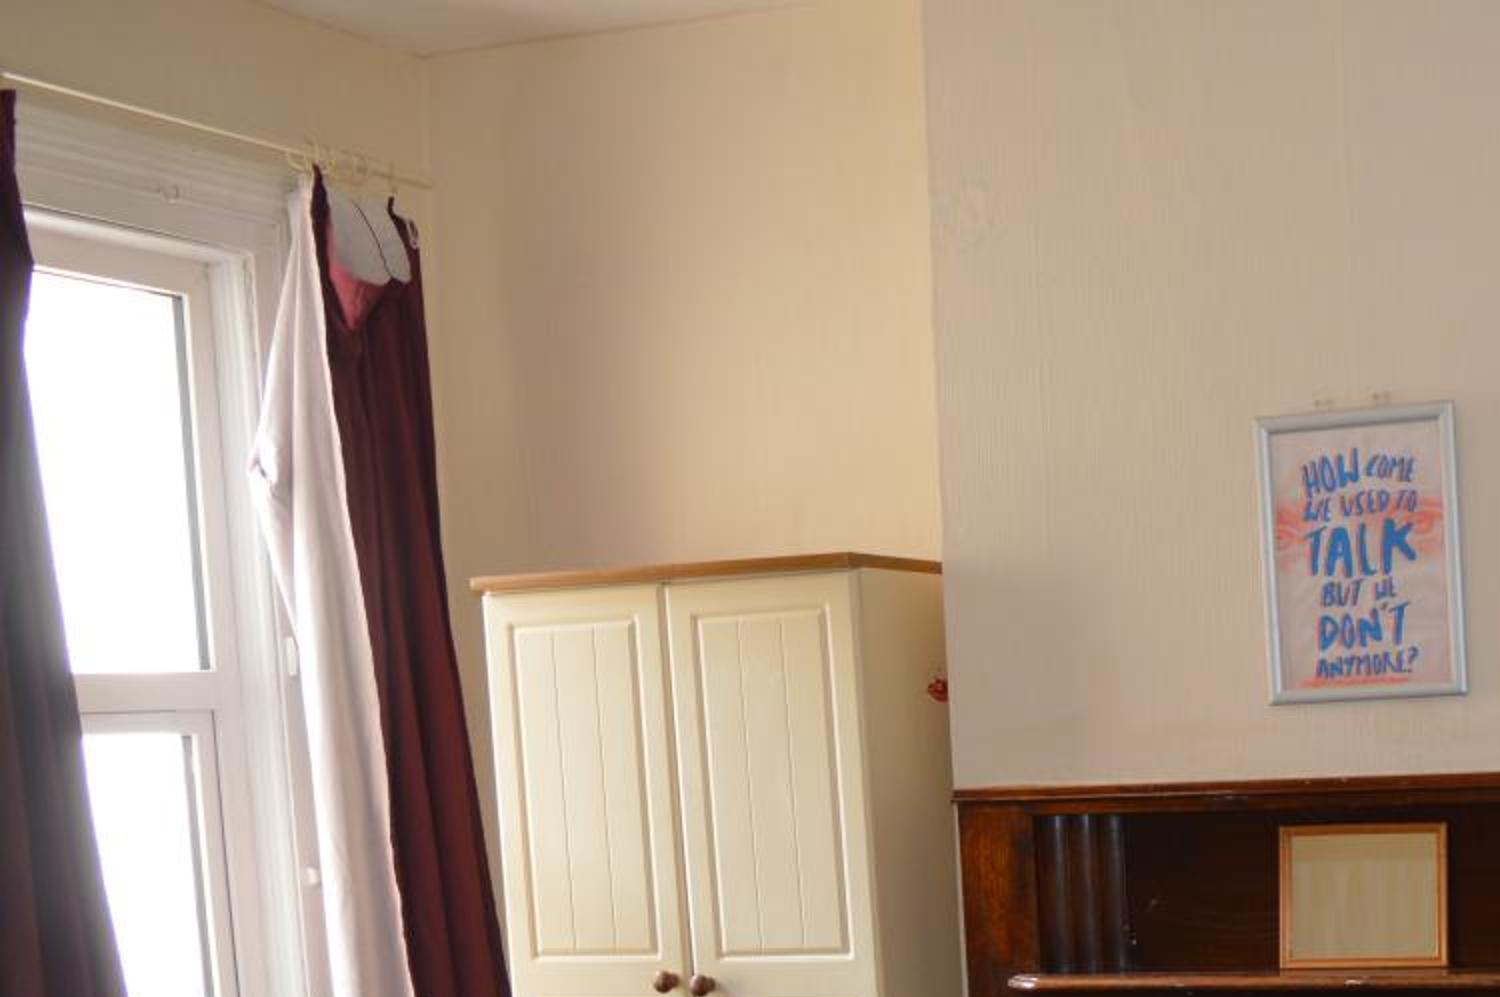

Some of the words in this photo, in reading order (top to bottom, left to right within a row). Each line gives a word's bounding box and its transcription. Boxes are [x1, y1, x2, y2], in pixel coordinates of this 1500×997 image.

[1303, 448, 1360, 497] HOW
[1366, 454, 1415, 482] COME
[1303, 501, 1331, 522] WE
[1340, 489, 1390, 517] USED
[1396, 489, 1418, 512] TO
[1305, 517, 1417, 577] TALK
[1321, 578, 1363, 607] BUT
[1318, 601, 1411, 651] DON'T
[1317, 646, 1419, 678] ANYMORE?
